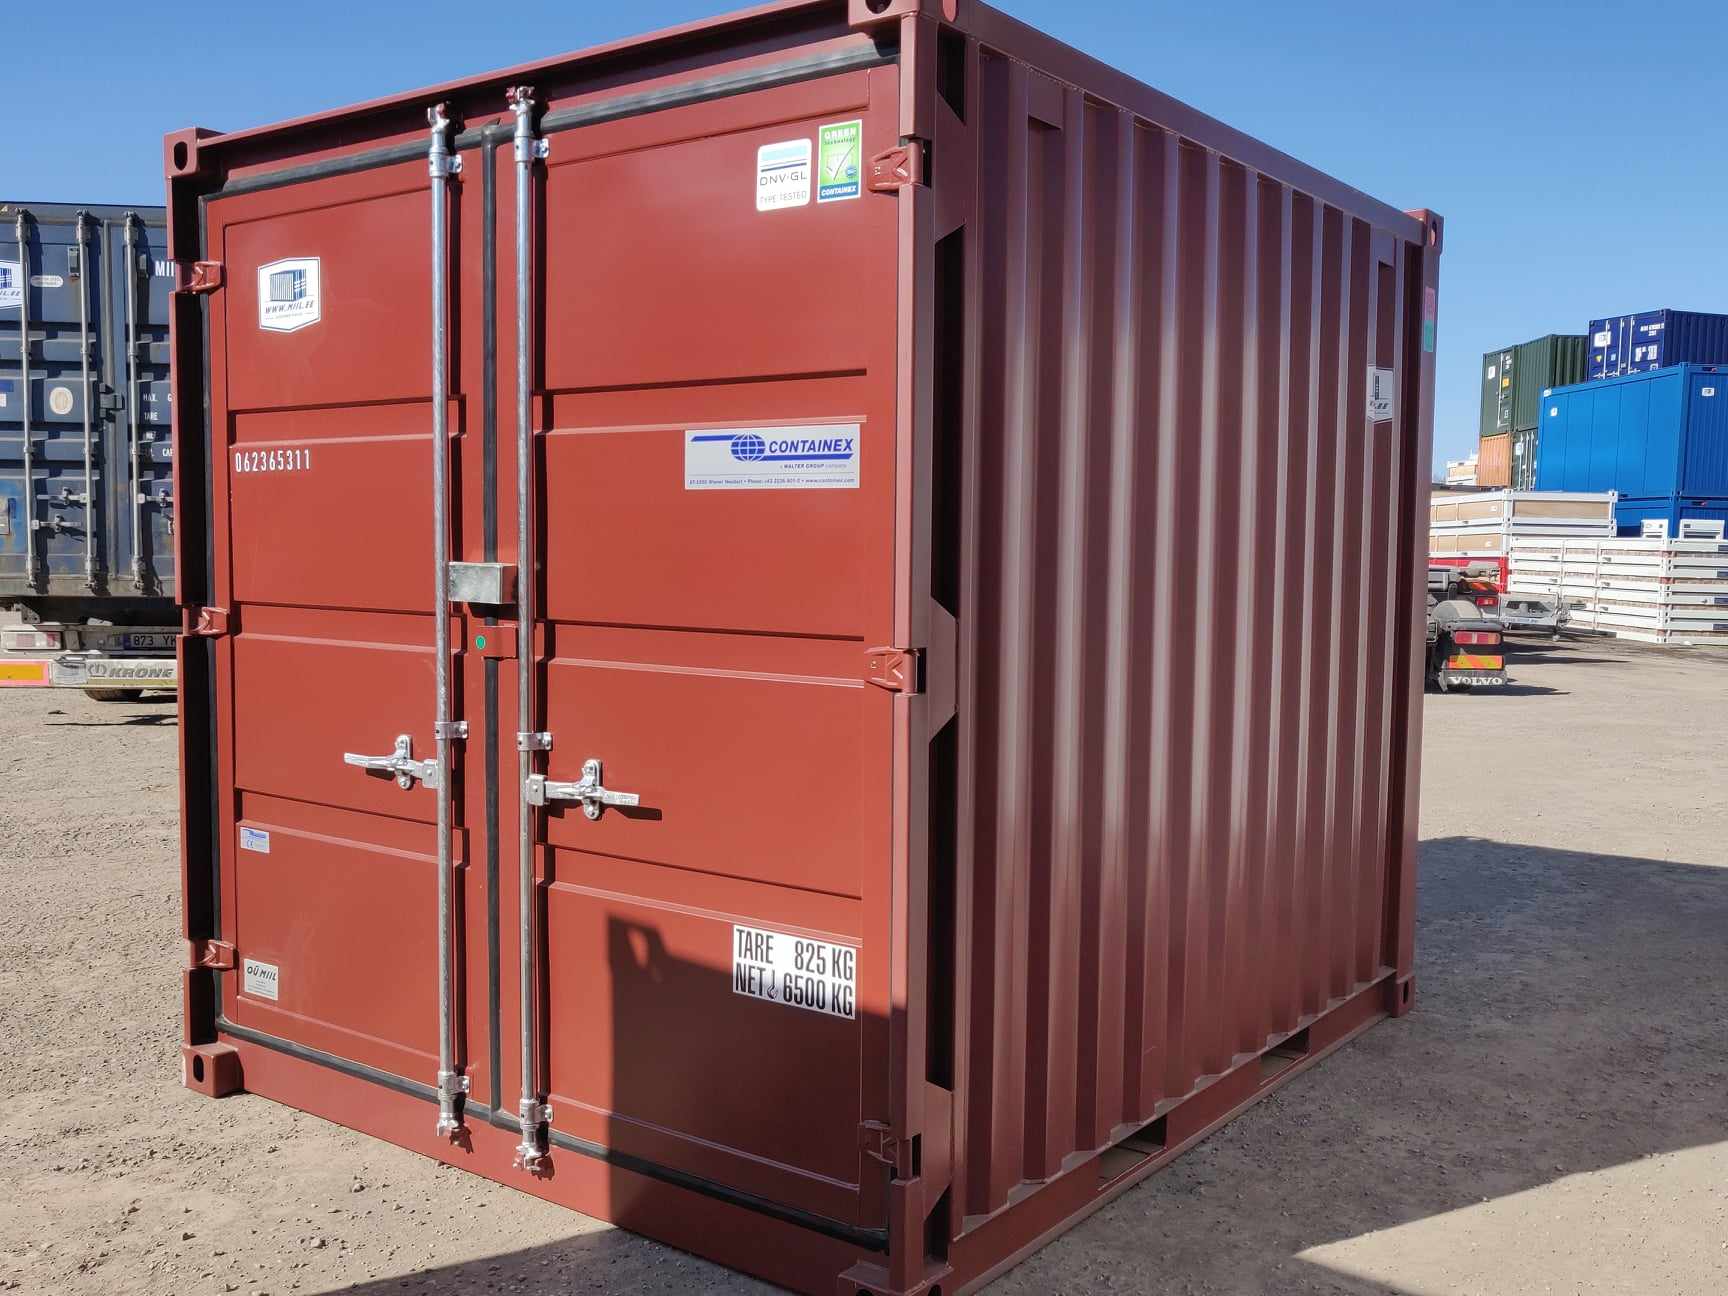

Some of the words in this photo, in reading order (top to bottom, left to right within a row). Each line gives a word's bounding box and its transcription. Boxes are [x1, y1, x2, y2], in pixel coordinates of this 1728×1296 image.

[769, 438, 854, 454] CONTAINEX
[234, 449, 311, 473] 062365311
[133, 635, 154, 646] 873
[109, 666, 174, 678] KRONE
[1448, 676, 1503, 686] VOLVO
[736, 928, 774, 964] TARE
[794, 940, 826, 975] 825
[831, 947, 854, 981] KG
[259, 969, 277, 982] MIIL
[735, 962, 766, 996] NET
[783, 972, 826, 1010] 6500
[831, 982, 853, 1017] KG
